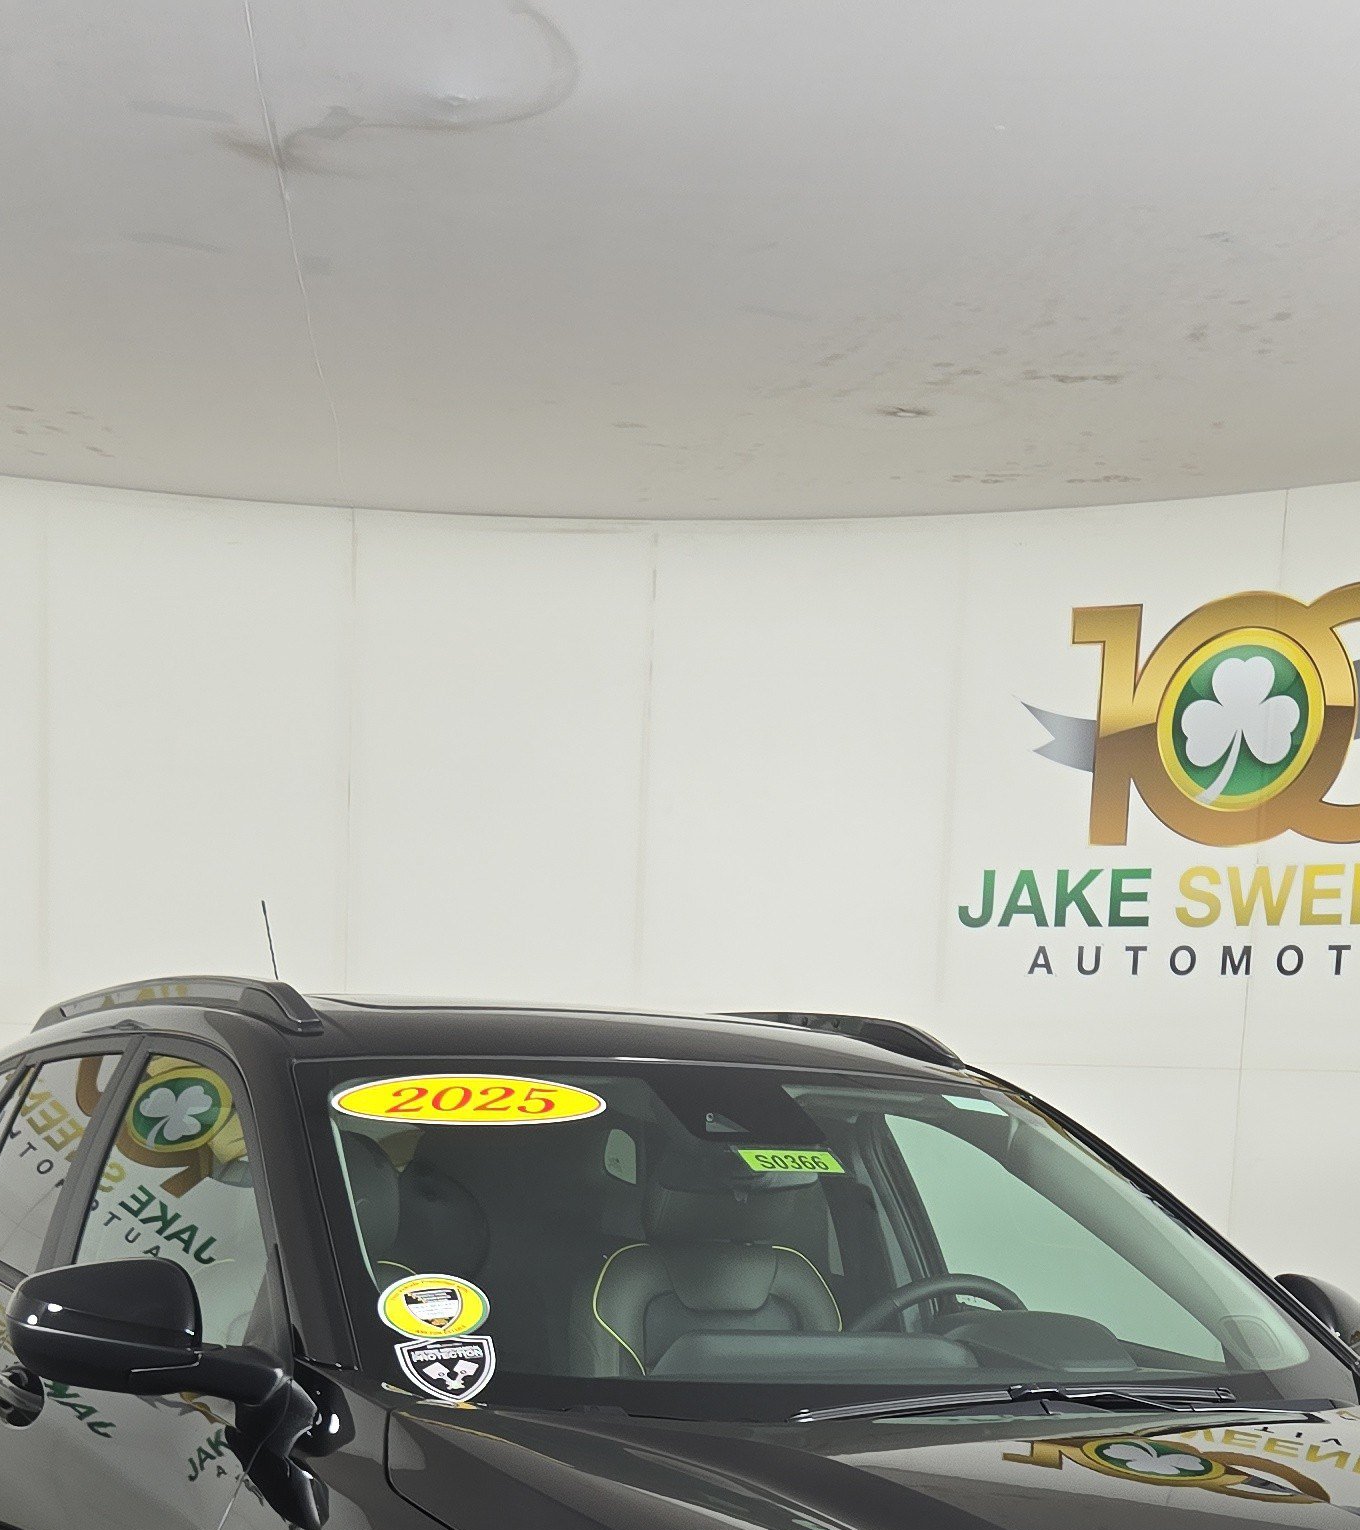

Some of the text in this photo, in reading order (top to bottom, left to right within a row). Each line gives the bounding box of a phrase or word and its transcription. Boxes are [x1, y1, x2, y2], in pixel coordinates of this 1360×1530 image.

[957, 868, 1152, 928] JAKE
[385, 1086, 558, 1114] 2025
[754, 1154, 830, 1171] S0366
